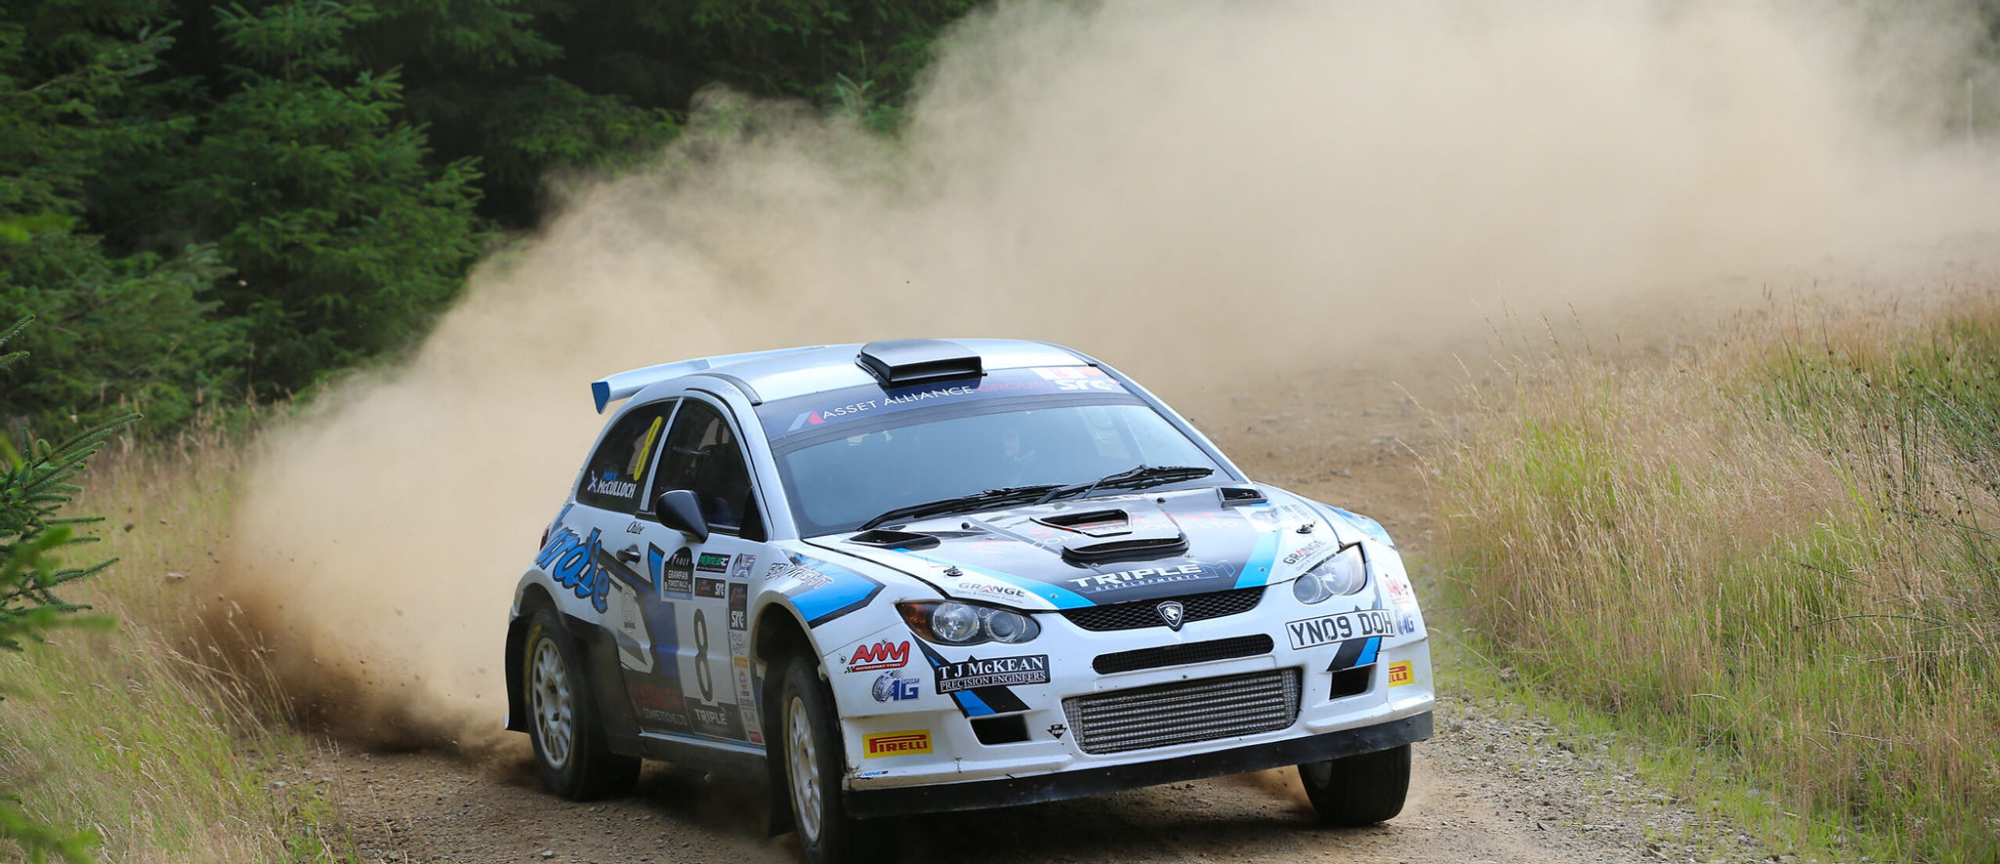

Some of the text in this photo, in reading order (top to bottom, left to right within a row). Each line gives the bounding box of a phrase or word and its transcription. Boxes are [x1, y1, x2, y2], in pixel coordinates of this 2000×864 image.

[823, 380, 1046, 420] ASSET ALLIANCE GROUP
[633, 416, 663, 481] 8
[1067, 564, 1202, 588] TRIPLE
[1095, 574, 1200, 592] DEVELOPMENTS
[958, 582, 1025, 598] GRANGE
[1290, 611, 1394, 646] YN09 DOH
[694, 608, 713, 702] 8
[938, 656, 1044, 679] T J McKEAN
[940, 671, 1047, 691] PRECISION ENGINEERS
[694, 708, 728, 725] TRIPLE
[869, 734, 928, 754] PIRELLI
